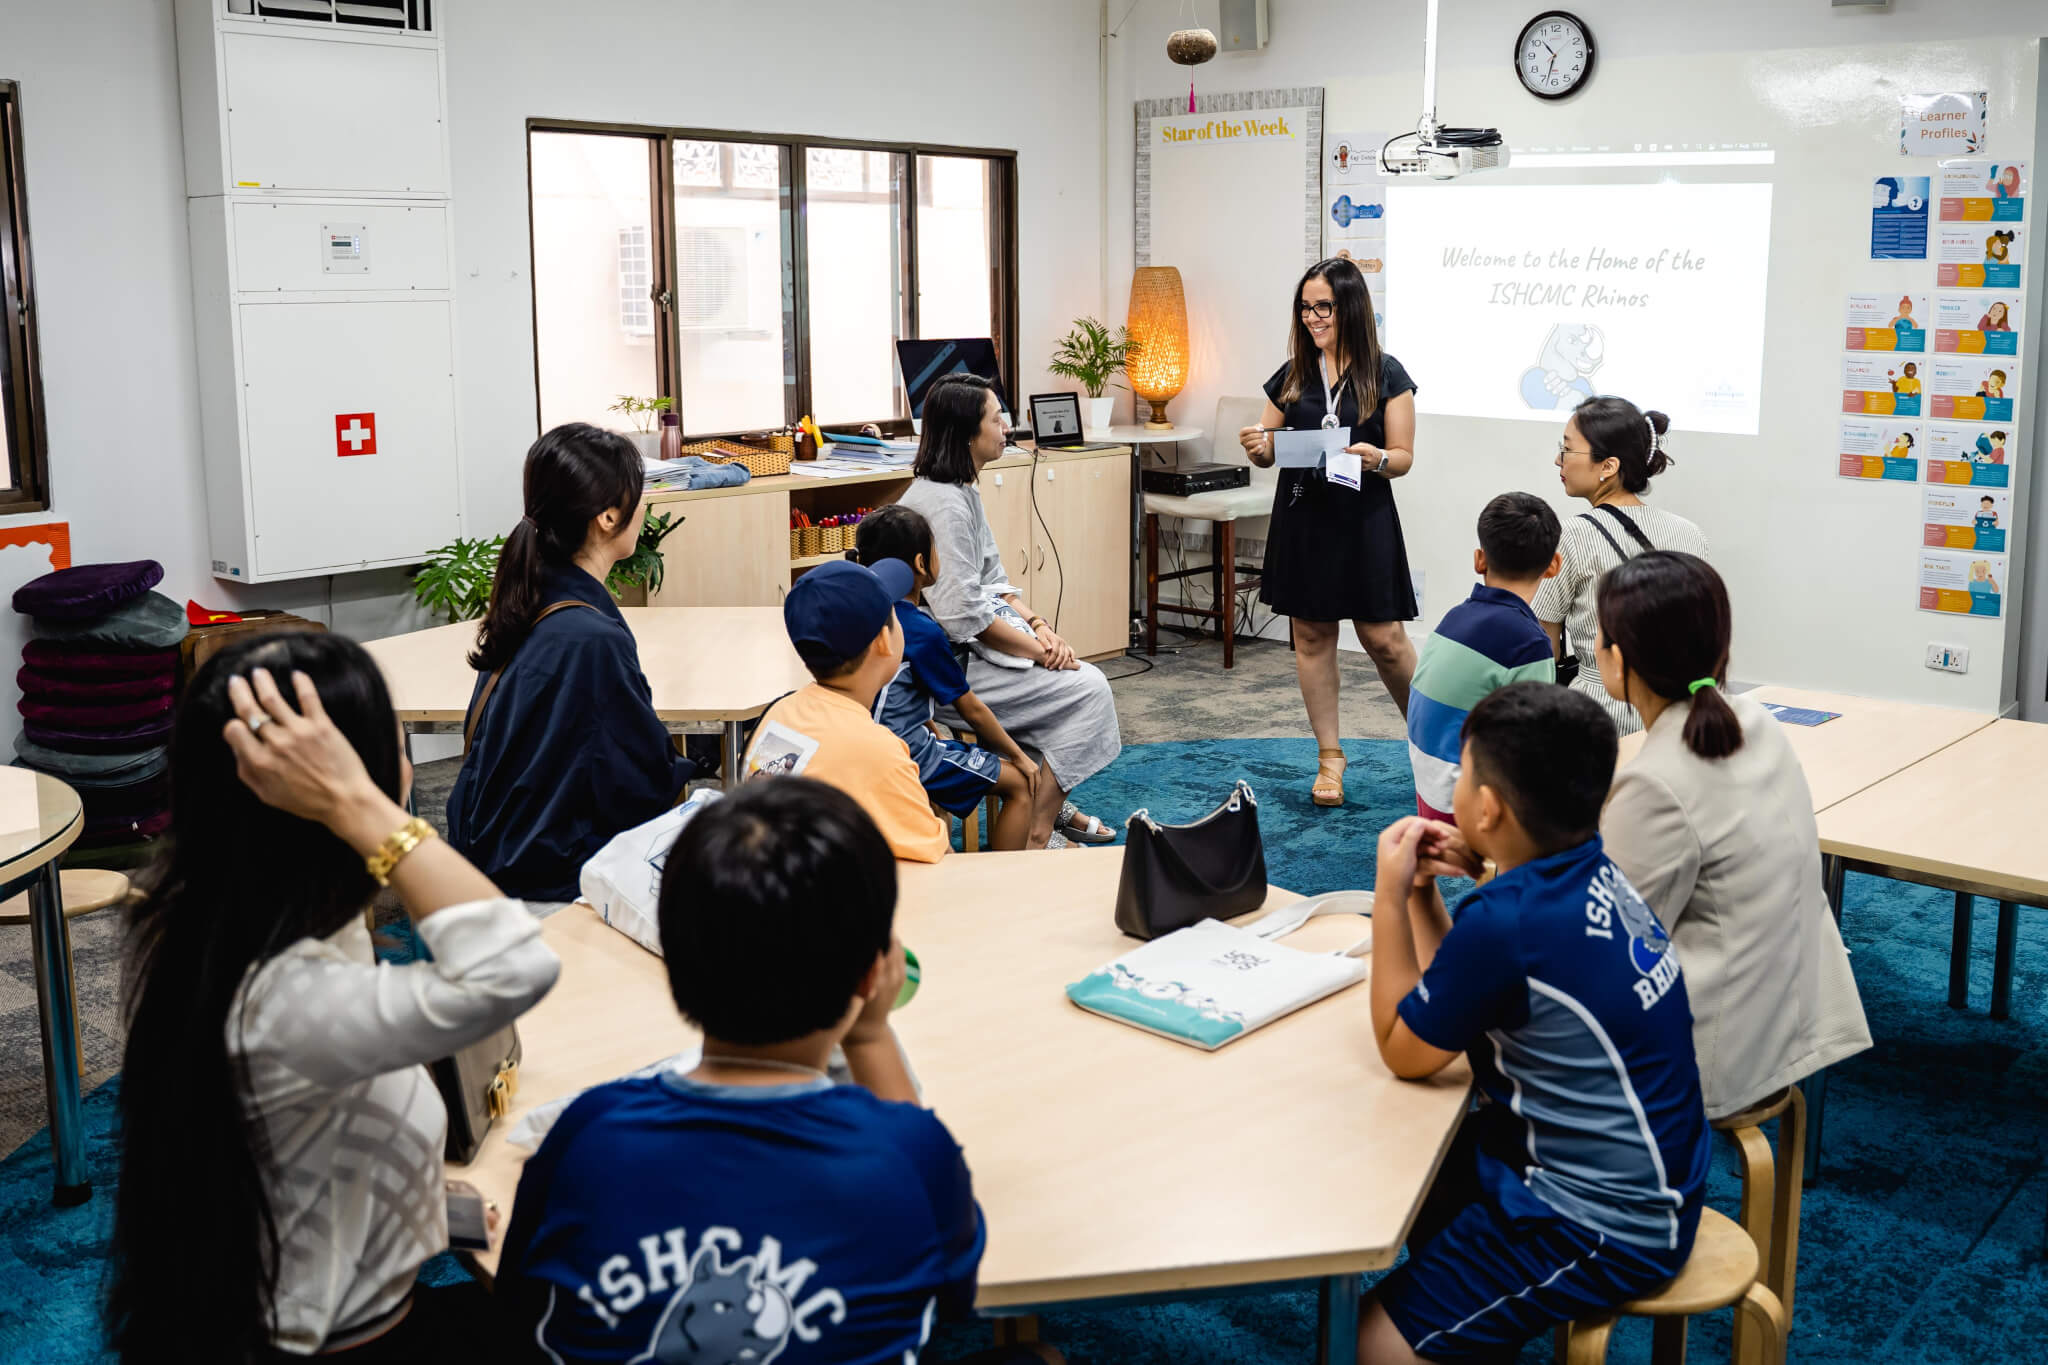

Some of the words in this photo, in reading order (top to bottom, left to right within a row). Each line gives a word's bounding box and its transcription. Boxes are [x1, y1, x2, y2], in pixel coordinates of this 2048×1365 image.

[1528, 52, 1535, 60] 9
[1540, 75, 1547, 83] 7
[1563, 74, 1570, 82] 5
[1920, 112, 1967, 121] Learner
[1162, 126, 1195, 143] Star
[1197, 121, 1214, 139] of
[1216, 120, 1241, 138] the
[1243, 117, 1289, 136] Week
[1921, 128, 1967, 139] Profiles
[1442, 247, 1516, 268] Welcome
[1522, 249, 1541, 268] to
[1548, 248, 1580, 269] the
[1585, 246, 1639, 271] Home
[1645, 249, 1669, 273] of
[1671, 249, 1705, 270] the
[1488, 282, 1576, 306] ISHCMC
[1580, 284, 1649, 308] Rhinos
